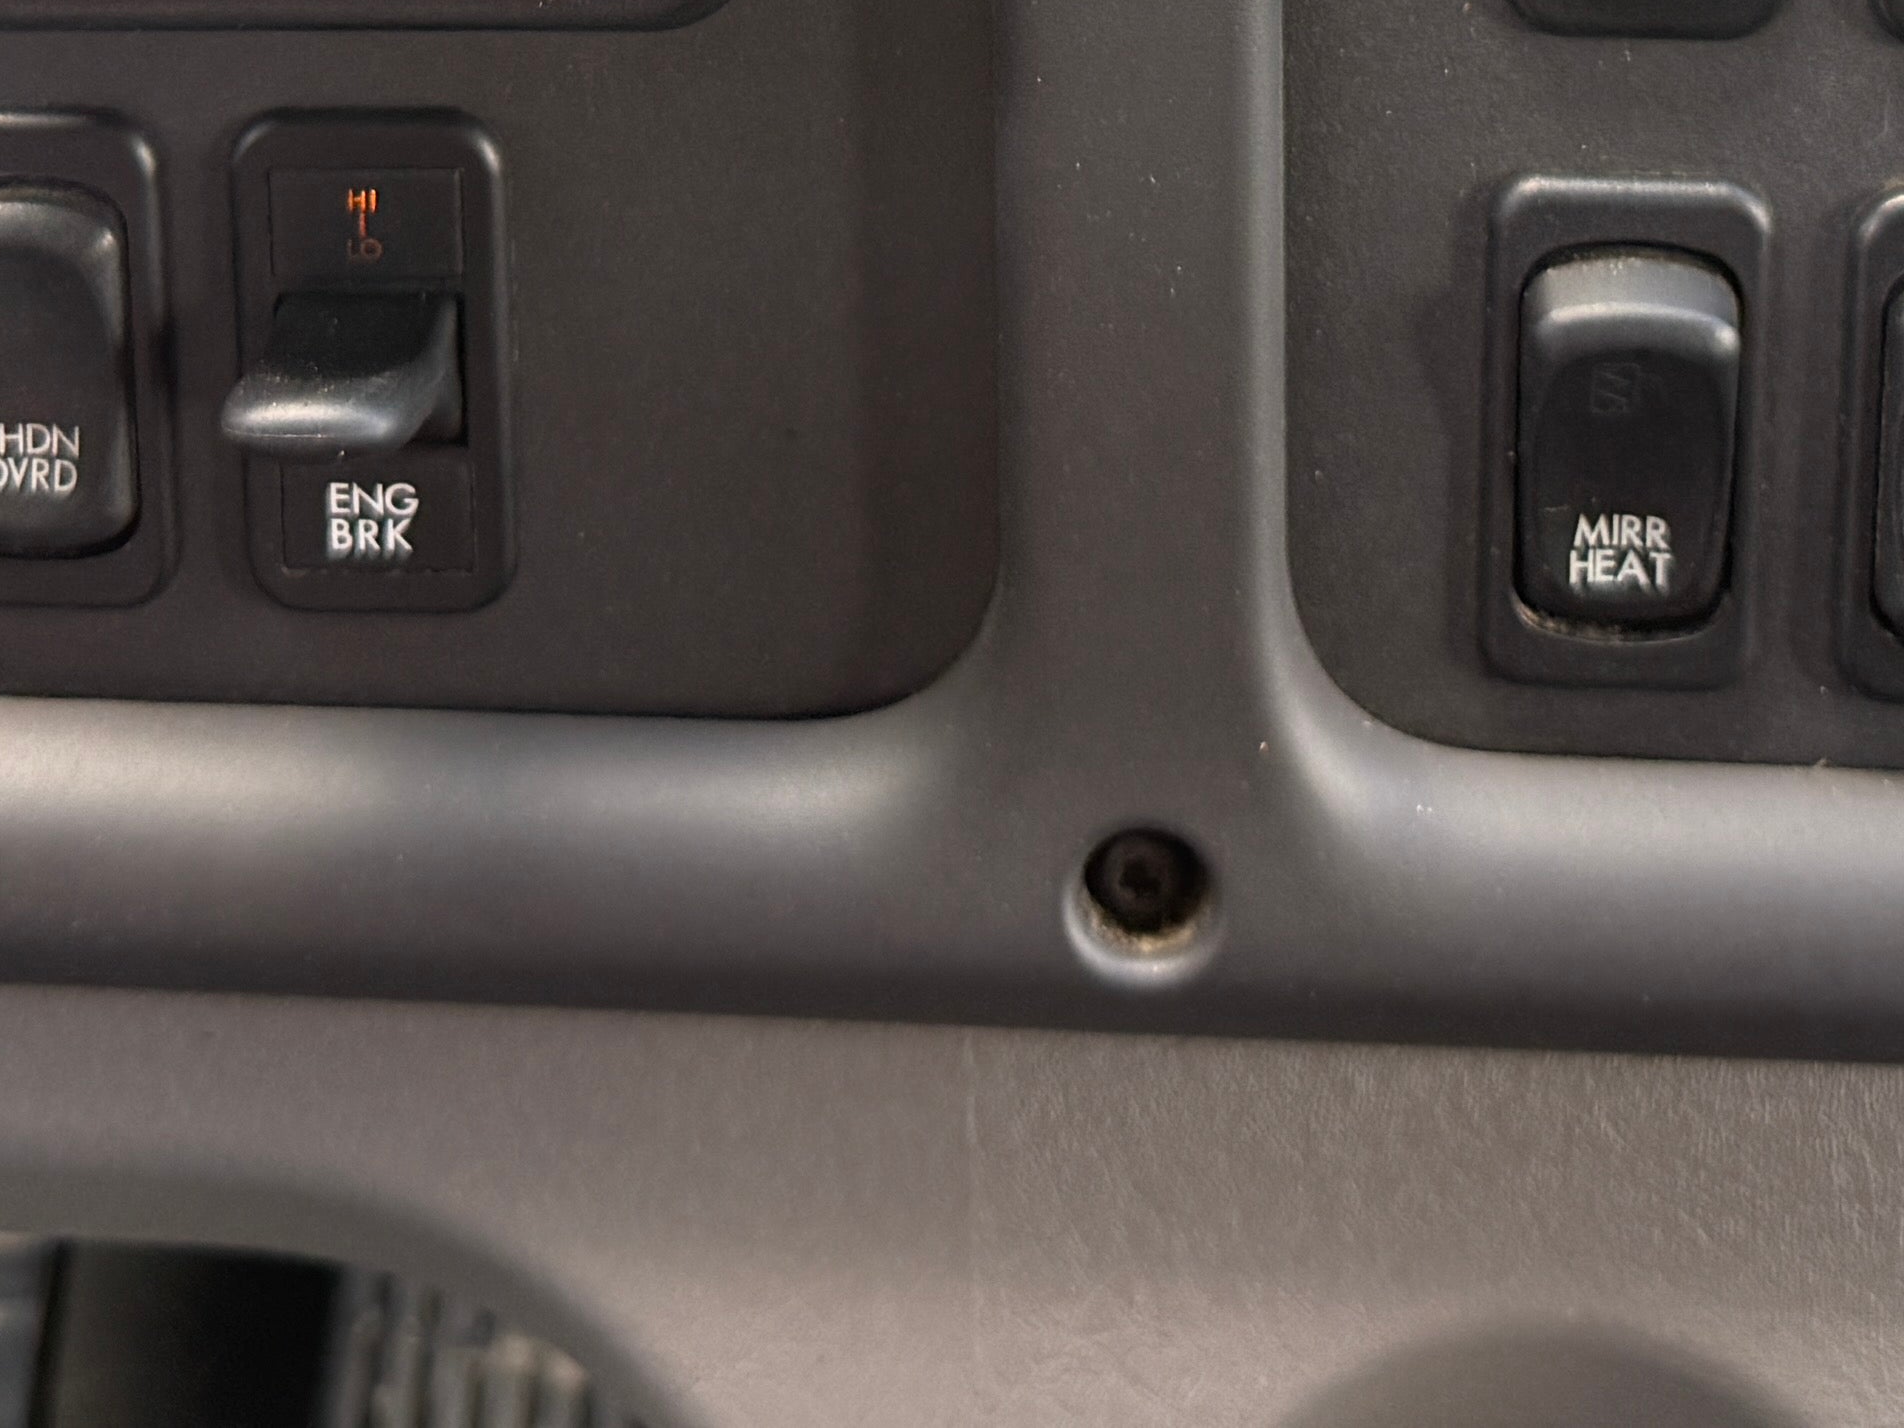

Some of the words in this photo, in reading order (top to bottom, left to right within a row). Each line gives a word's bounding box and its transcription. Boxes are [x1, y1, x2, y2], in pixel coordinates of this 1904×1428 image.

[347, 188, 377, 214] HI
[327, 482, 419, 516] ENG
[327, 519, 413, 554] BRK
[1574, 513, 1669, 549] MIRR
[1570, 549, 1672, 587] HEAT
